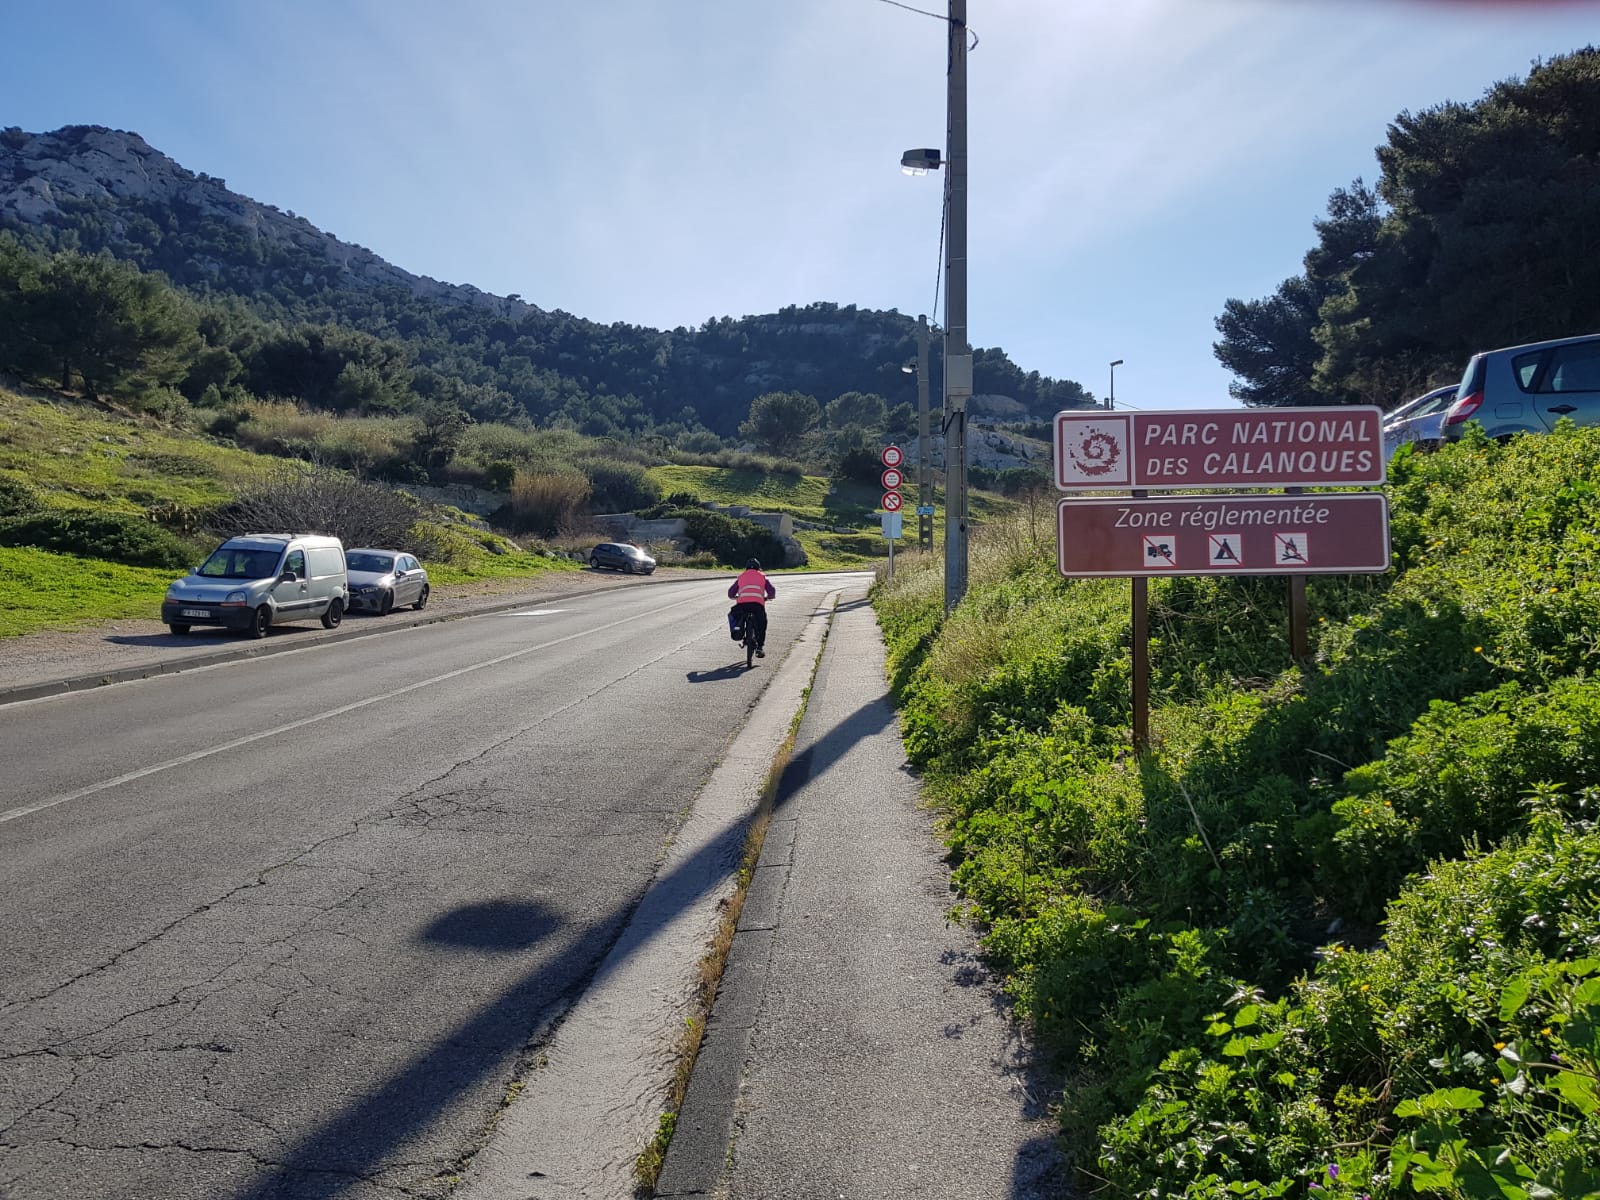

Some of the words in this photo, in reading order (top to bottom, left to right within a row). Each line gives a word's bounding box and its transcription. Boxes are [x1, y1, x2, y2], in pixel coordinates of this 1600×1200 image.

[1144, 423, 1219, 445] PARC
[1232, 421, 1370, 444] NATIONAL
[1146, 458, 1189, 475] DES
[1203, 451, 1372, 475] CALANQUES
[1114, 508, 1172, 528] Zone
[1180, 504, 1330, 530] réglementée
